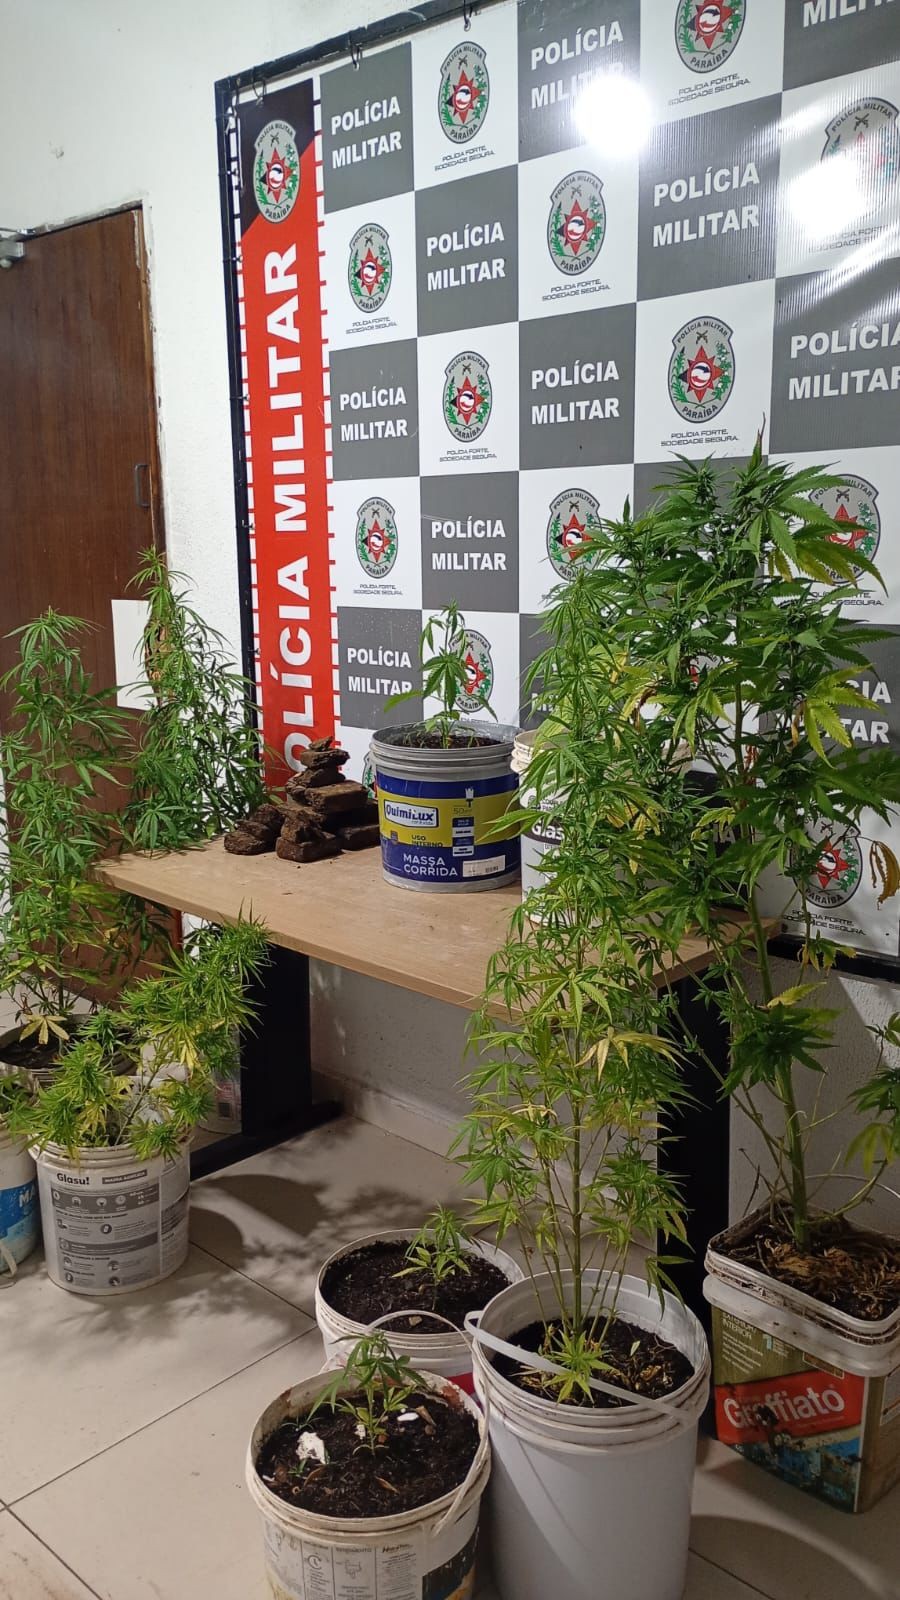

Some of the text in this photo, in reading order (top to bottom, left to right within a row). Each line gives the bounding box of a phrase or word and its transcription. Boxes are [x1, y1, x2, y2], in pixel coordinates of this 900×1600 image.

[463, 46, 482, 58] MILITAR
[531, 20, 624, 71] POLÍCIA
[690, 49, 728, 68] PARAÍBA
[331, 96, 401, 136] POLÍCIA
[832, 102, 893, 132] POLÍCIA MILITAR
[450, 124, 478, 139] PARAÍBA
[332, 131, 402, 169] MILITAR
[654, 162, 760, 208] POLÍCIA
[652, 204, 760, 248] MILITAR
[426, 221, 505, 257] POLÍCIA
[426, 257, 506, 292] MILITAR
[677, 321, 728, 343] POLÍCIA MILITAR
[531, 360, 620, 390] POLÍCIA
[339, 386, 406, 410] POLÍCIA
[531, 397, 620, 425] MILITAR
[682, 404, 718, 419] PARAÍBA
[340, 418, 408, 442] MILITAR
[264, 243, 314, 775] OLÍCIA MILITAR
[554, 492, 596, 510] POLÍCIA MILITAR
[431, 516, 506, 539] POLÍCIA
[432, 552, 506, 570] MILITAR
[347, 646, 412, 668] POLÍCIA
[348, 675, 412, 696] MILITAR
[404, 864, 458, 876] CORRIDA
[56, 1172, 90, 1185] Glasu!
